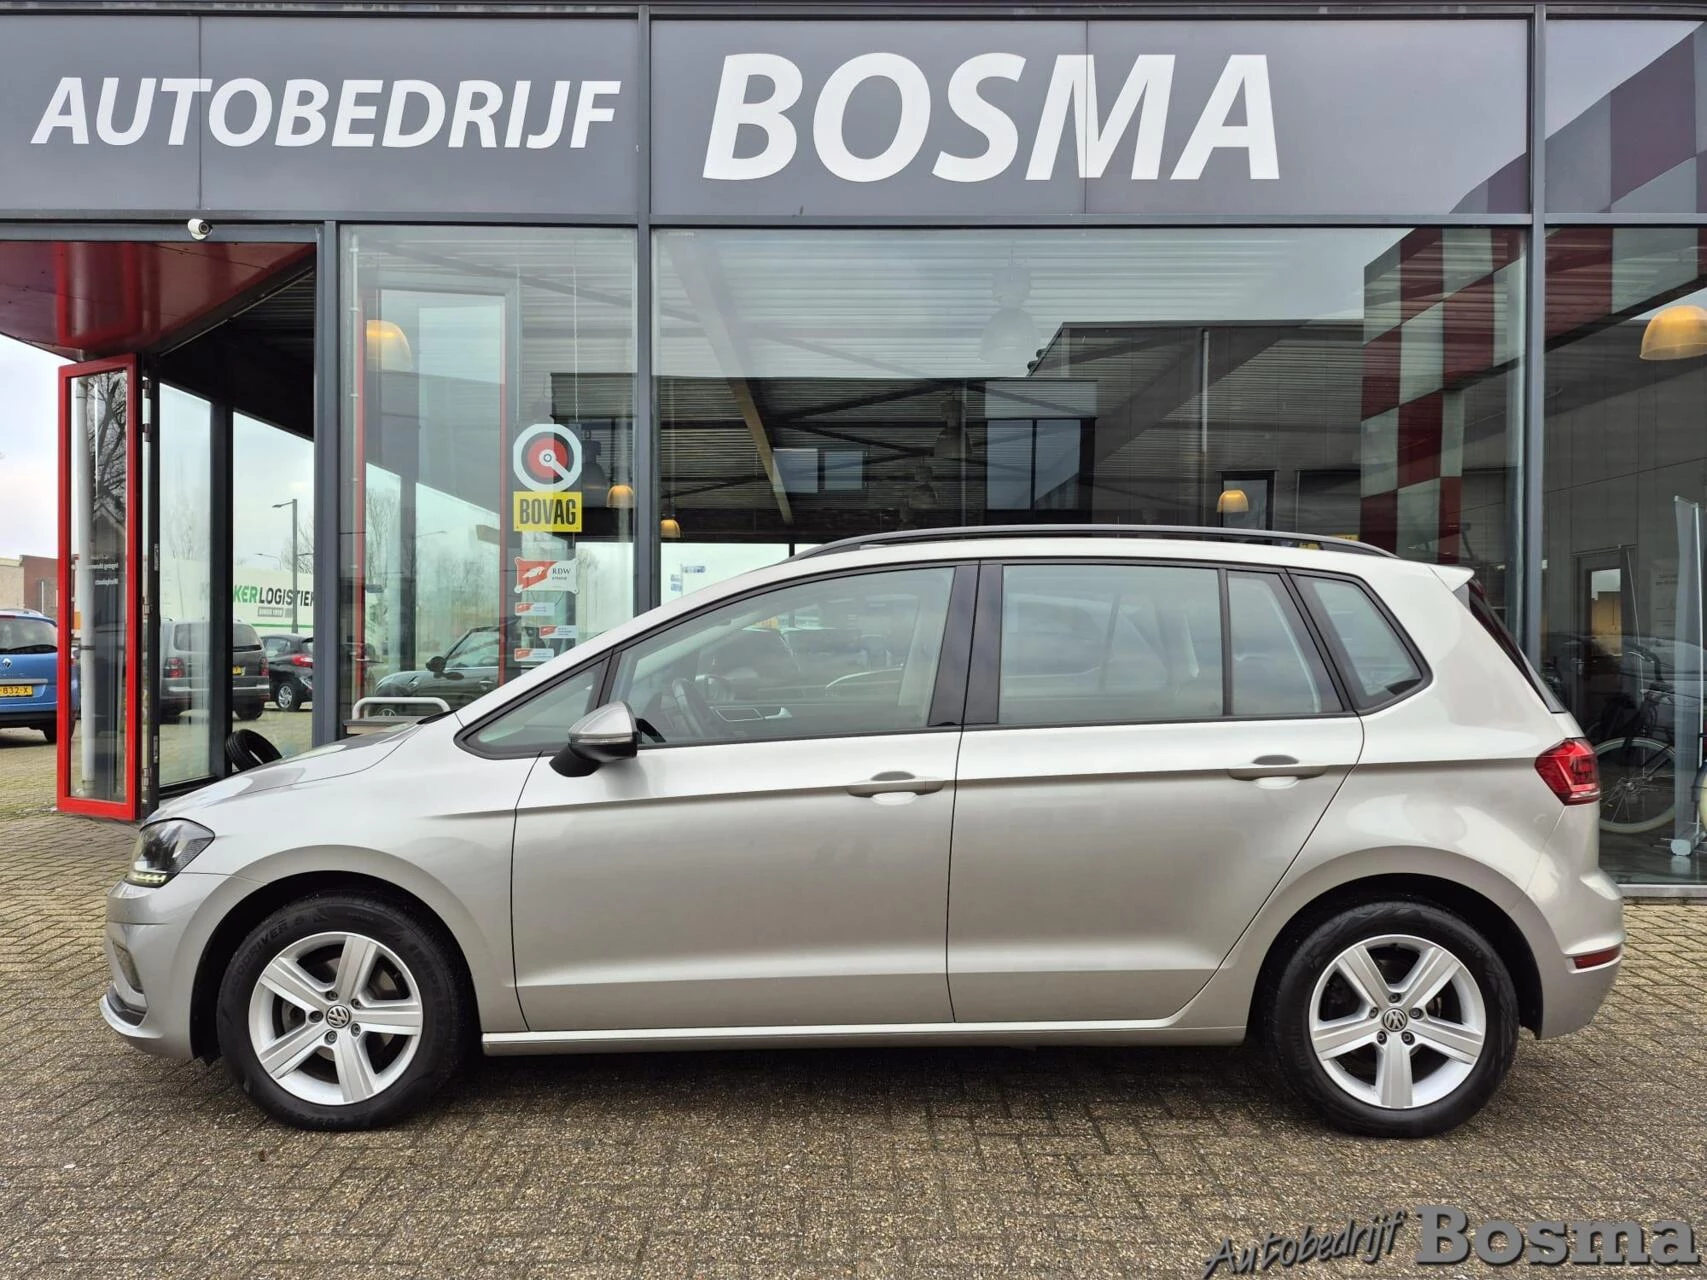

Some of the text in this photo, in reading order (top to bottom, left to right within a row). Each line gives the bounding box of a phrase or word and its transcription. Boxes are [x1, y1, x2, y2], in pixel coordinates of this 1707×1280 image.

[30, 52, 1281, 183] AUTOBEDRIJF BOSMA
[519, 498, 576, 526] BOVAG
[552, 567, 571, 575] RDW
[258, 586, 313, 607] LOGISIE
